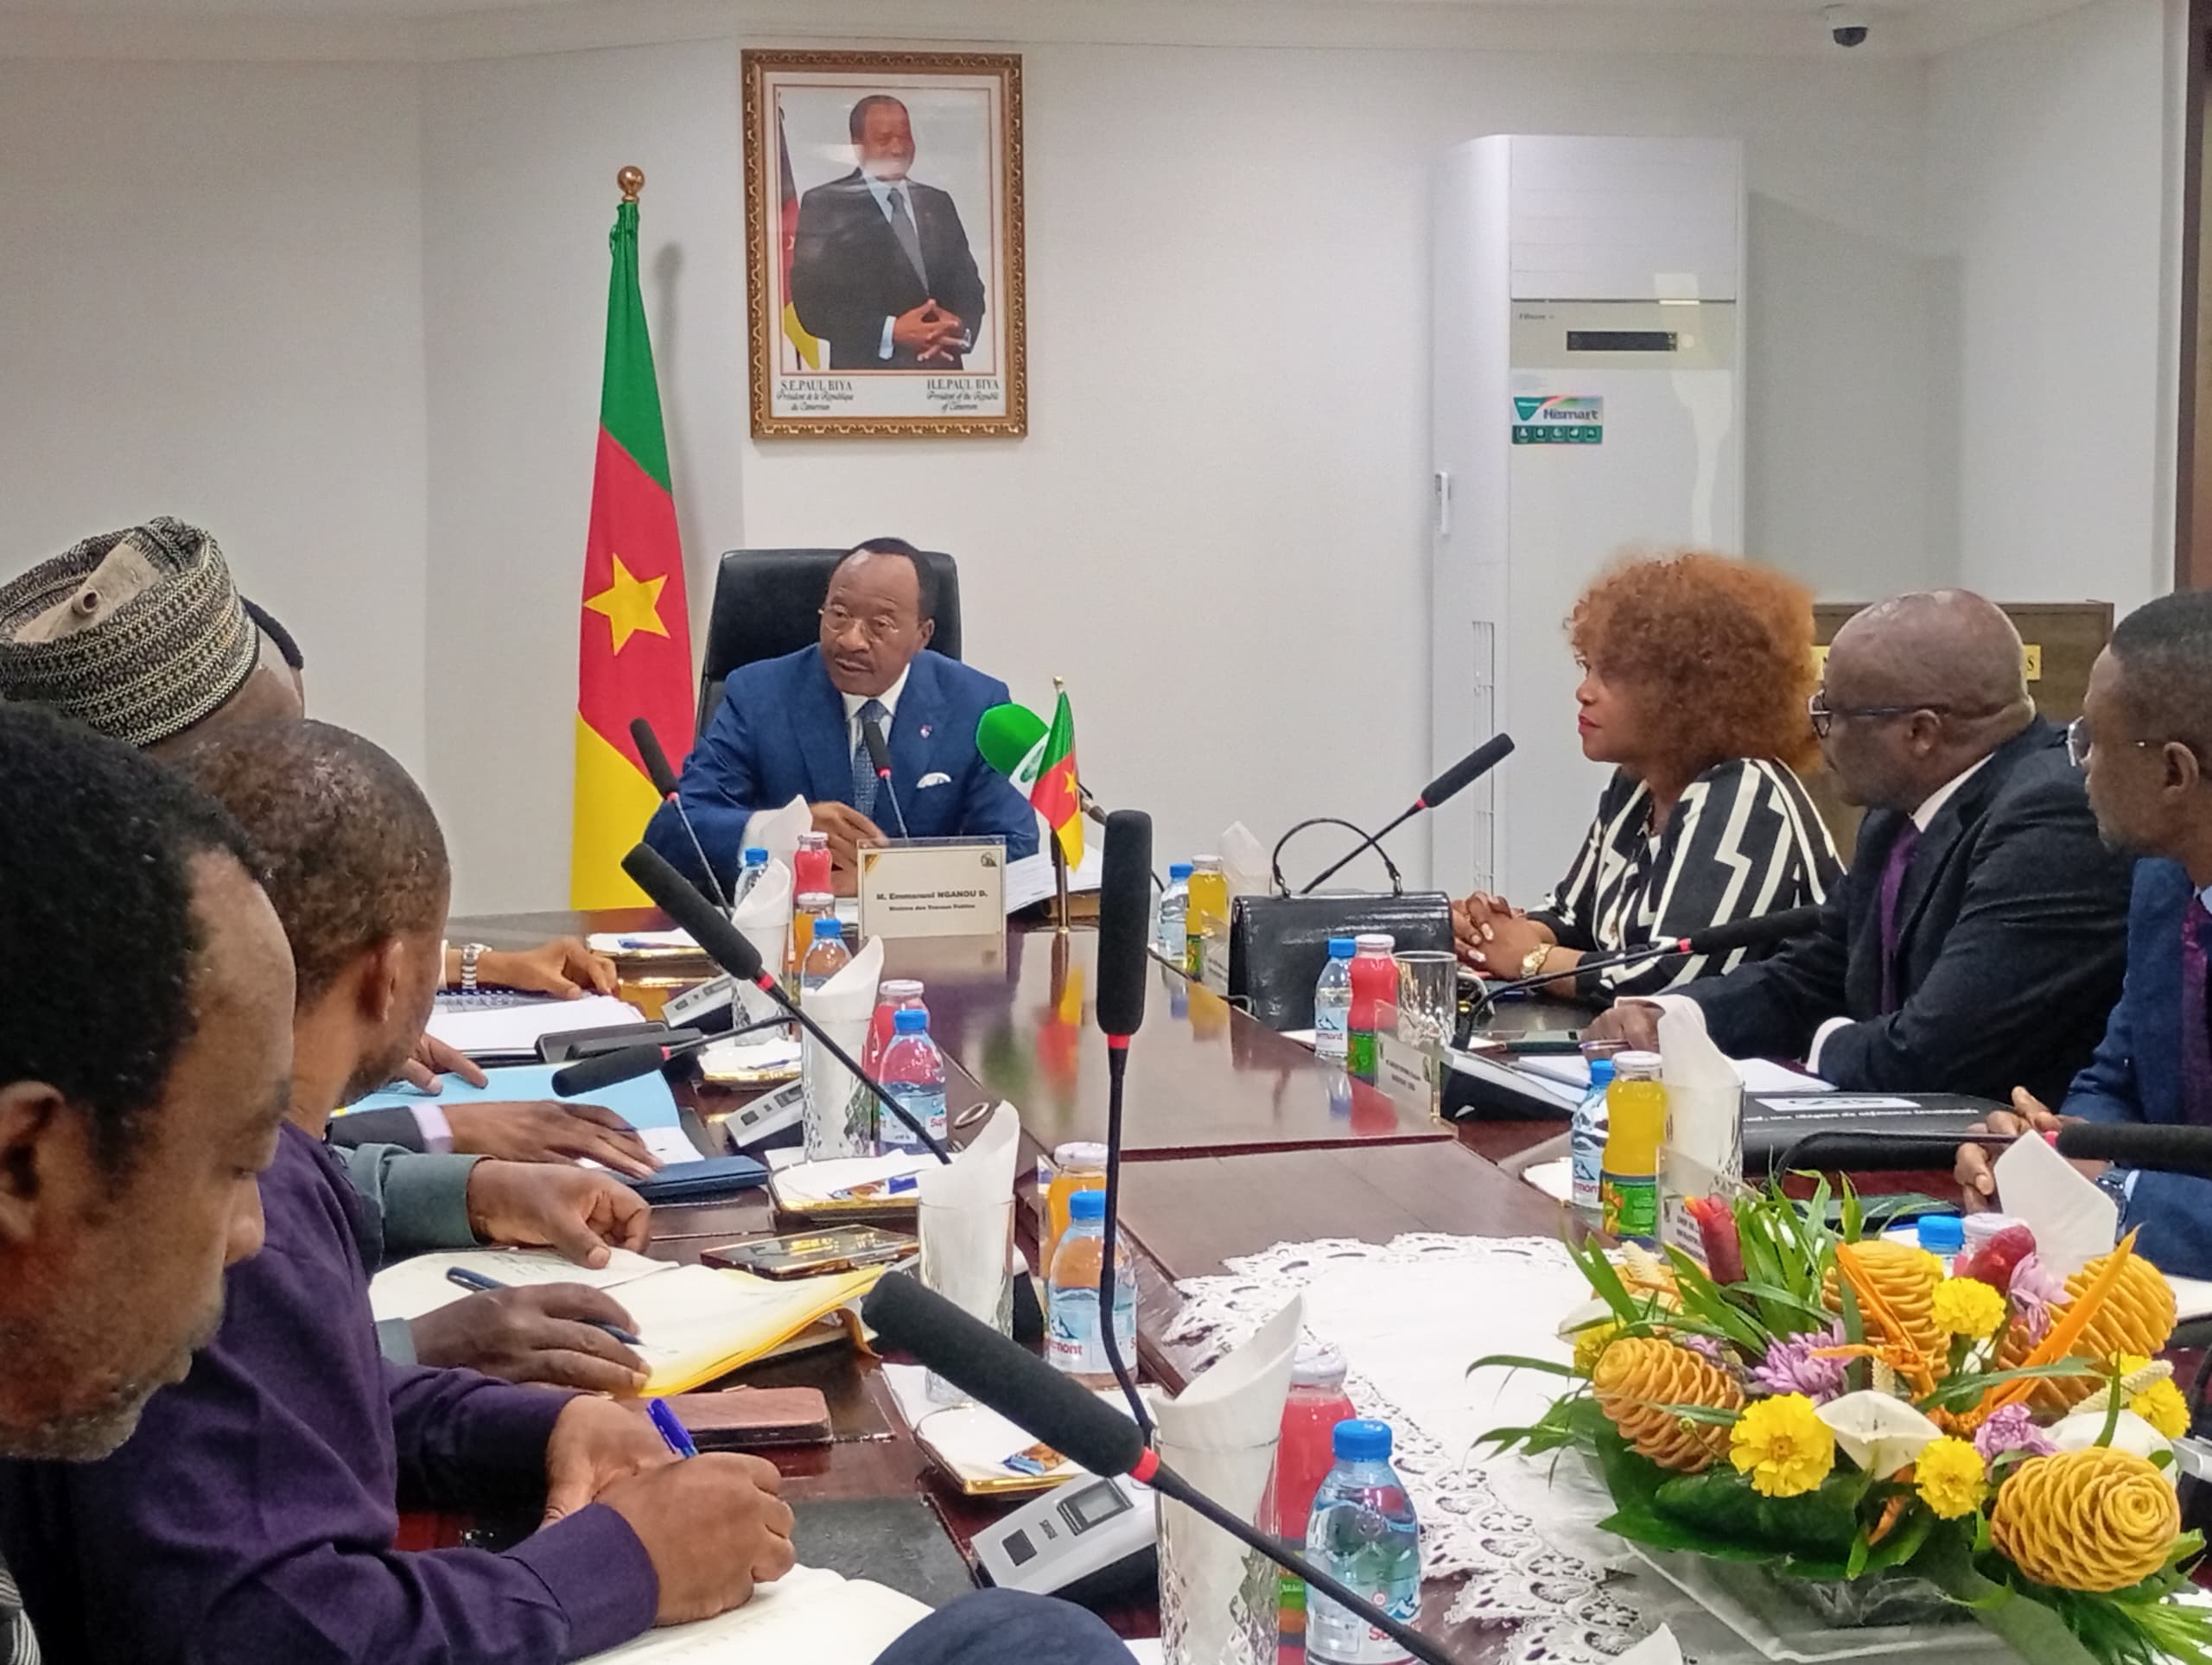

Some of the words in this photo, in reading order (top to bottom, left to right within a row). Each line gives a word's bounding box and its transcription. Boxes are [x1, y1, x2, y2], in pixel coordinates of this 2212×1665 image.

[829, 379, 852, 391] BIYA
[976, 378, 999, 390] BIYA
[889, 892, 935, 900] Emmanuel
